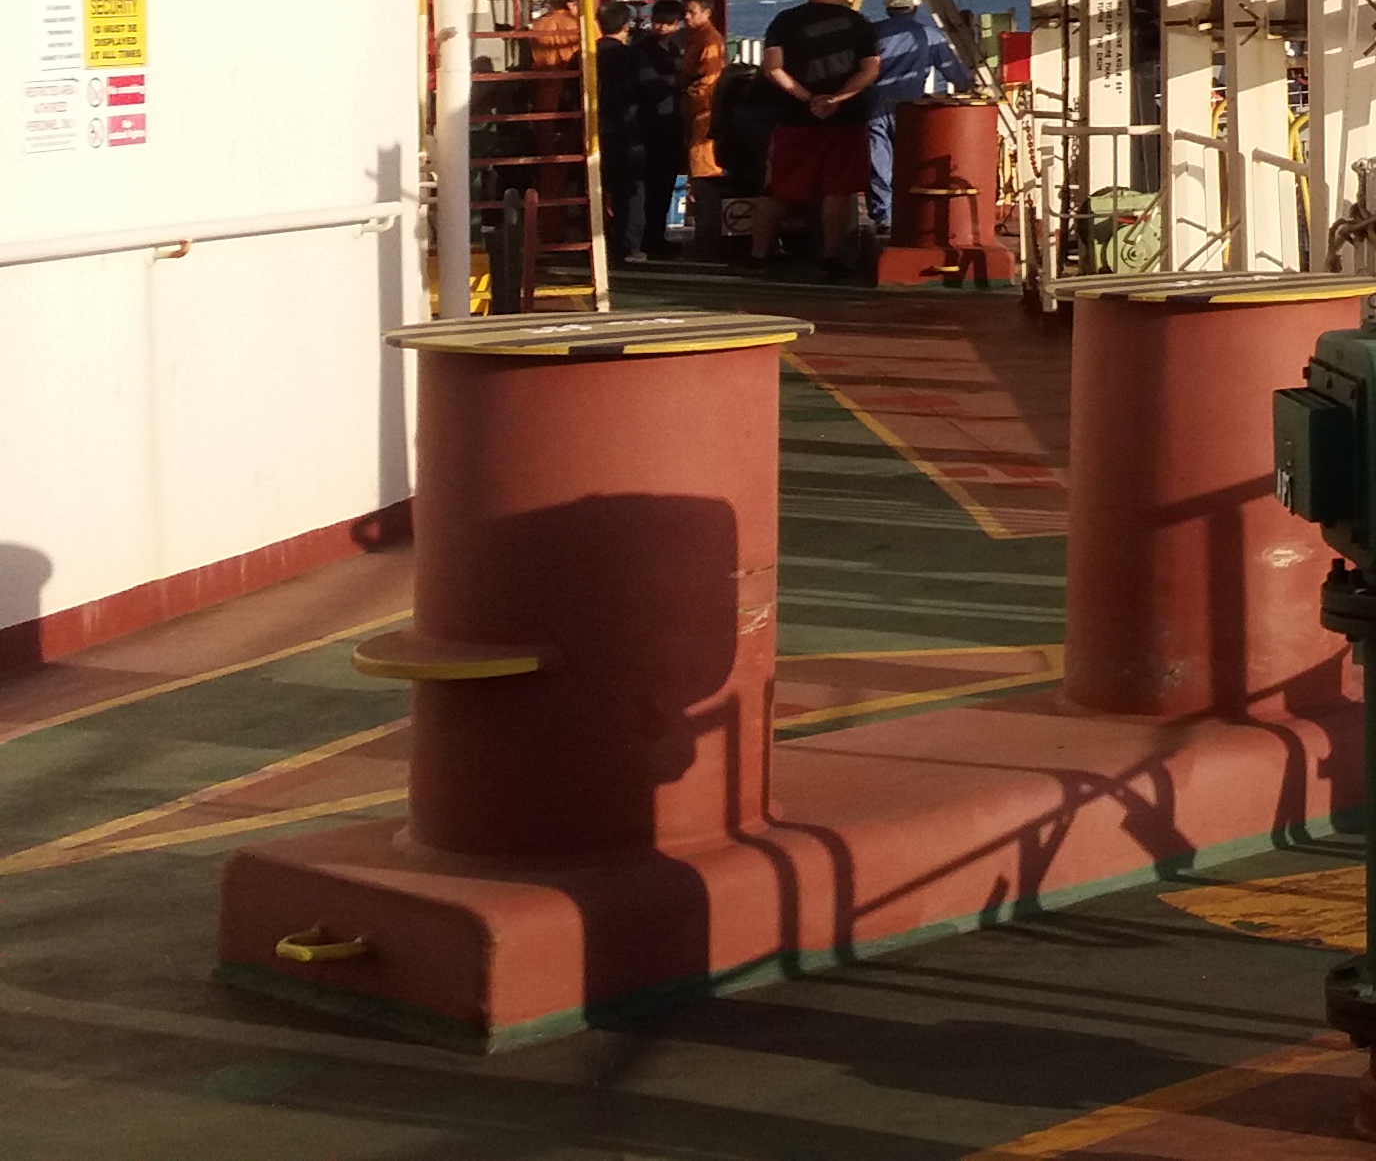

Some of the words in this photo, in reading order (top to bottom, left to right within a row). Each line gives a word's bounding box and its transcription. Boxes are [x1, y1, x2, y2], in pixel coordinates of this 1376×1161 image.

[103, 24, 125, 33] MUST
[127, 24, 138, 33] BE
[94, 36, 138, 47] DISPLAYED
[90, 51, 100, 60] AT
[102, 50, 116, 59] ALL
[118, 48, 142, 58] TIMES
